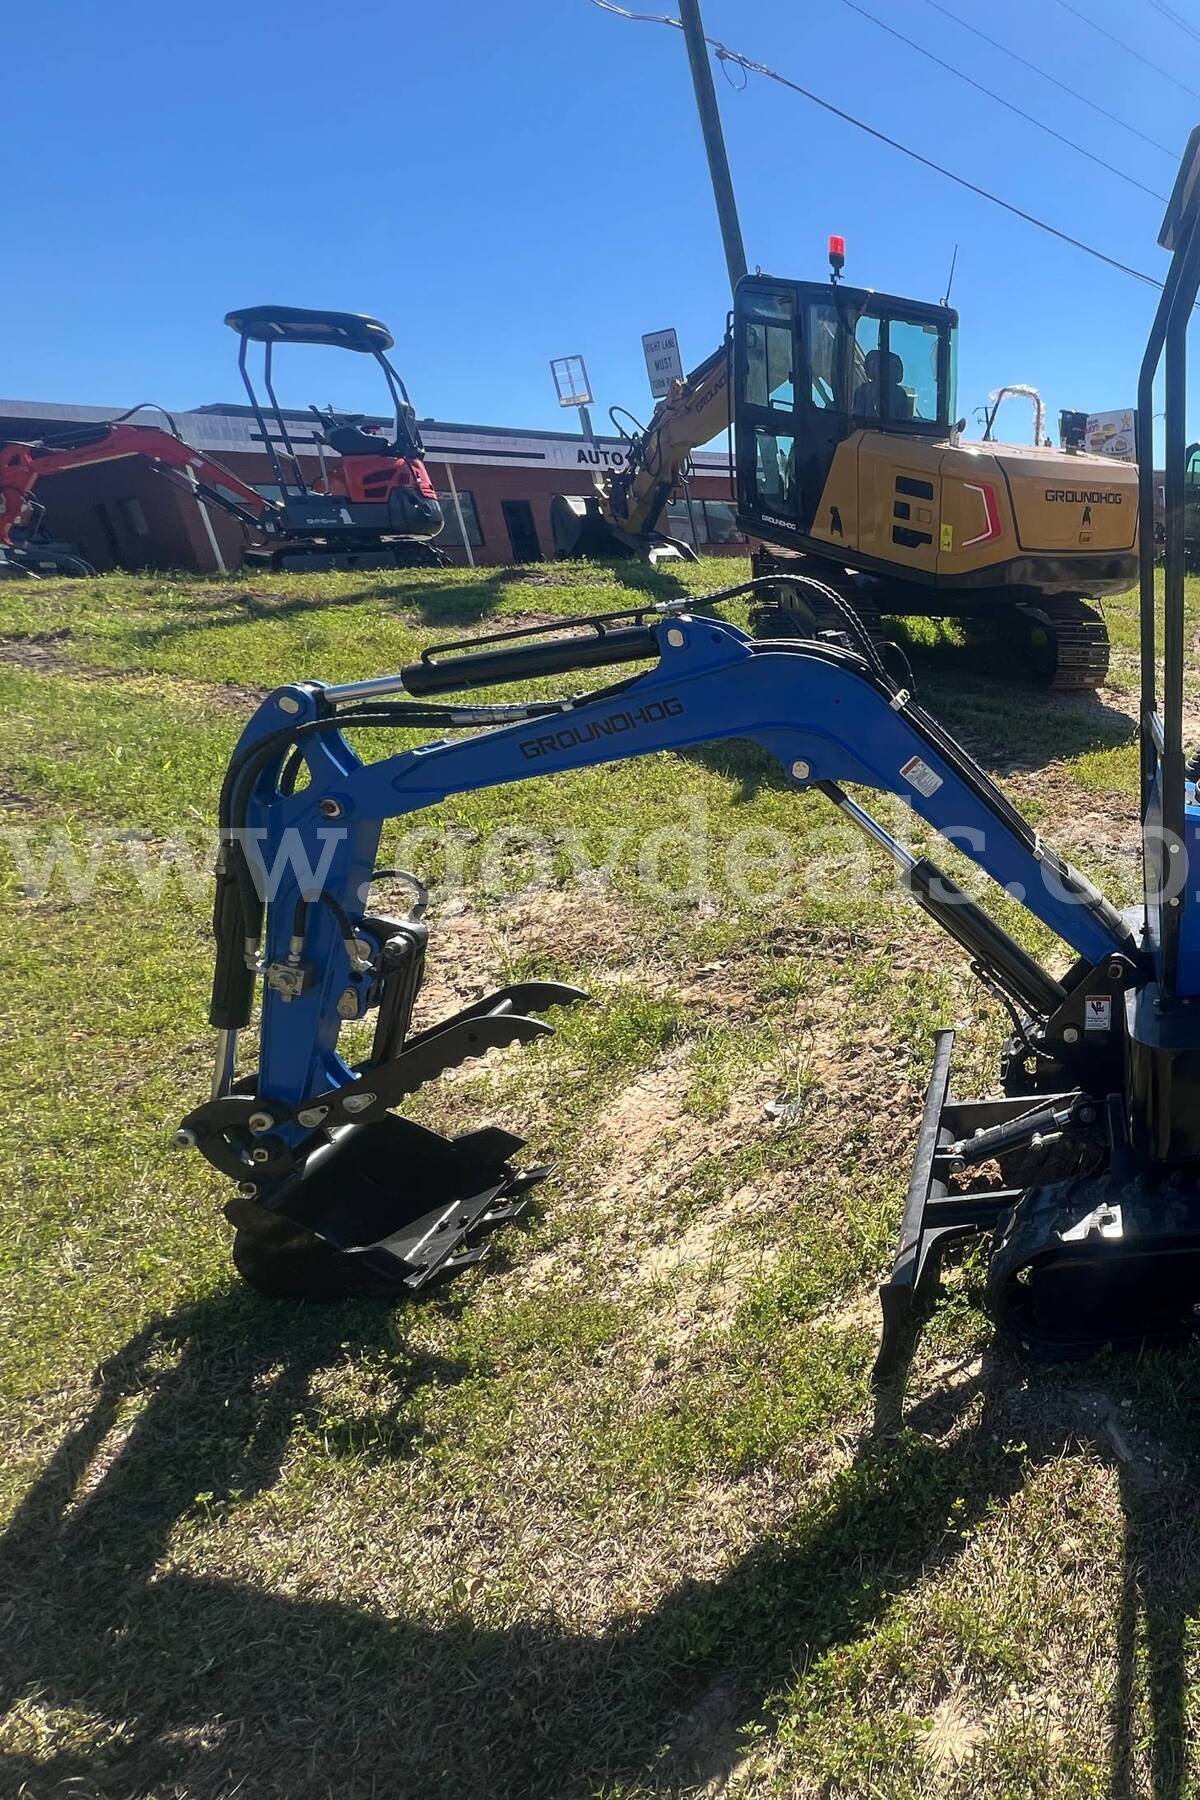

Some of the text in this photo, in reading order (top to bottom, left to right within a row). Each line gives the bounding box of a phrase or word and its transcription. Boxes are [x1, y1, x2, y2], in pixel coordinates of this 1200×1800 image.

[654, 356, 672, 371] MUST
[1044, 489, 1122, 504] GROUNDHOG
[519, 697, 684, 760] GROUNDHOG
